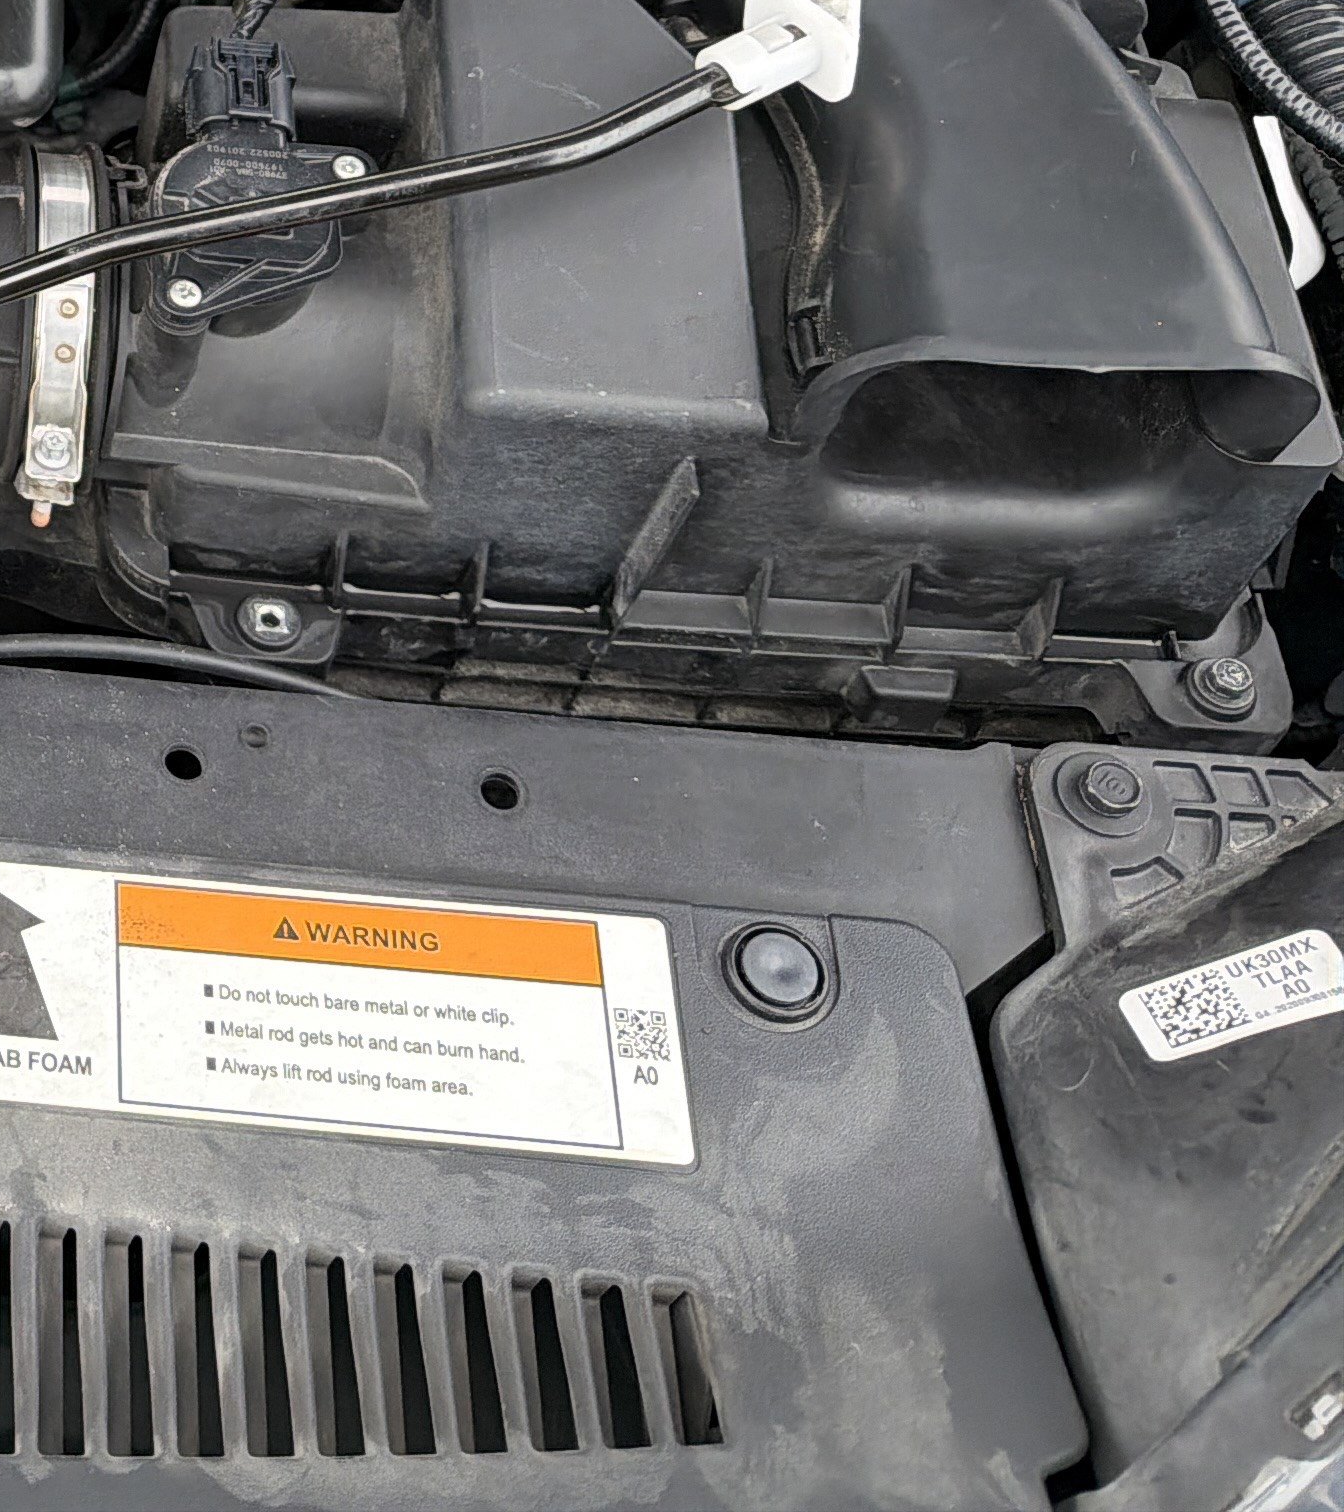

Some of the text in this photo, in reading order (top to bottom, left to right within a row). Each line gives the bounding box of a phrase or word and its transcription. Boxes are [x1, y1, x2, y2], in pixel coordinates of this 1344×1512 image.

[305, 919, 440, 953] WARNING
[1224, 936, 1319, 978] UK30MX
[1251, 959, 1314, 989] TLAA
[218, 984, 516, 1028] Do not touch bare metal or white clip.
[220, 1020, 526, 1064] Metal rod gets hot and can burn hand.
[28, 1050, 93, 1077] FOAM
[220, 1057, 474, 1097] Always lift rod using foam area.
